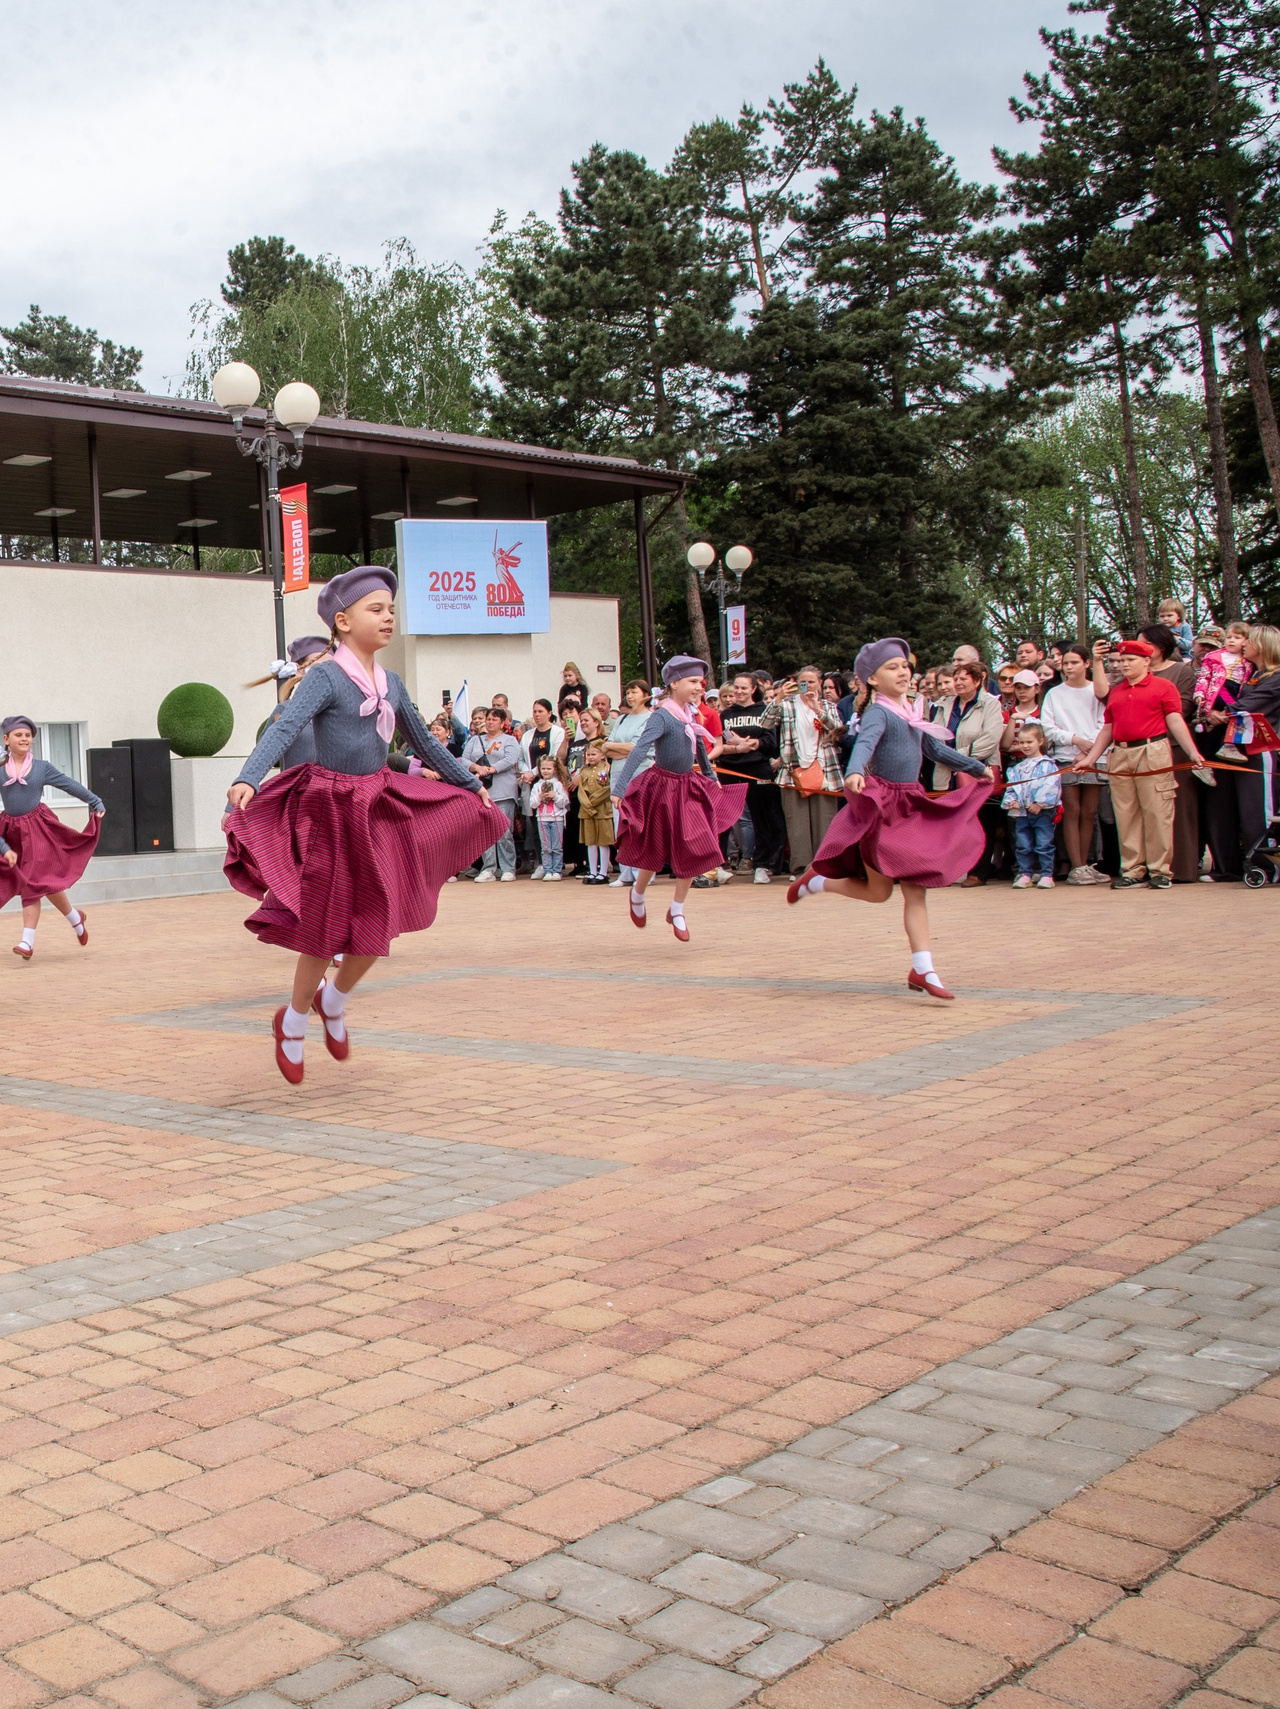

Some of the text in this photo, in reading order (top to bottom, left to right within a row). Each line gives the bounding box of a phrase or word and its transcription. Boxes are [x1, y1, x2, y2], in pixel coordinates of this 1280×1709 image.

[429, 571, 476, 592] 2025
[486, 583, 507, 603] 80
[487, 606, 525, 618] ПОБЕДА!
[732, 619, 740, 635] 9
